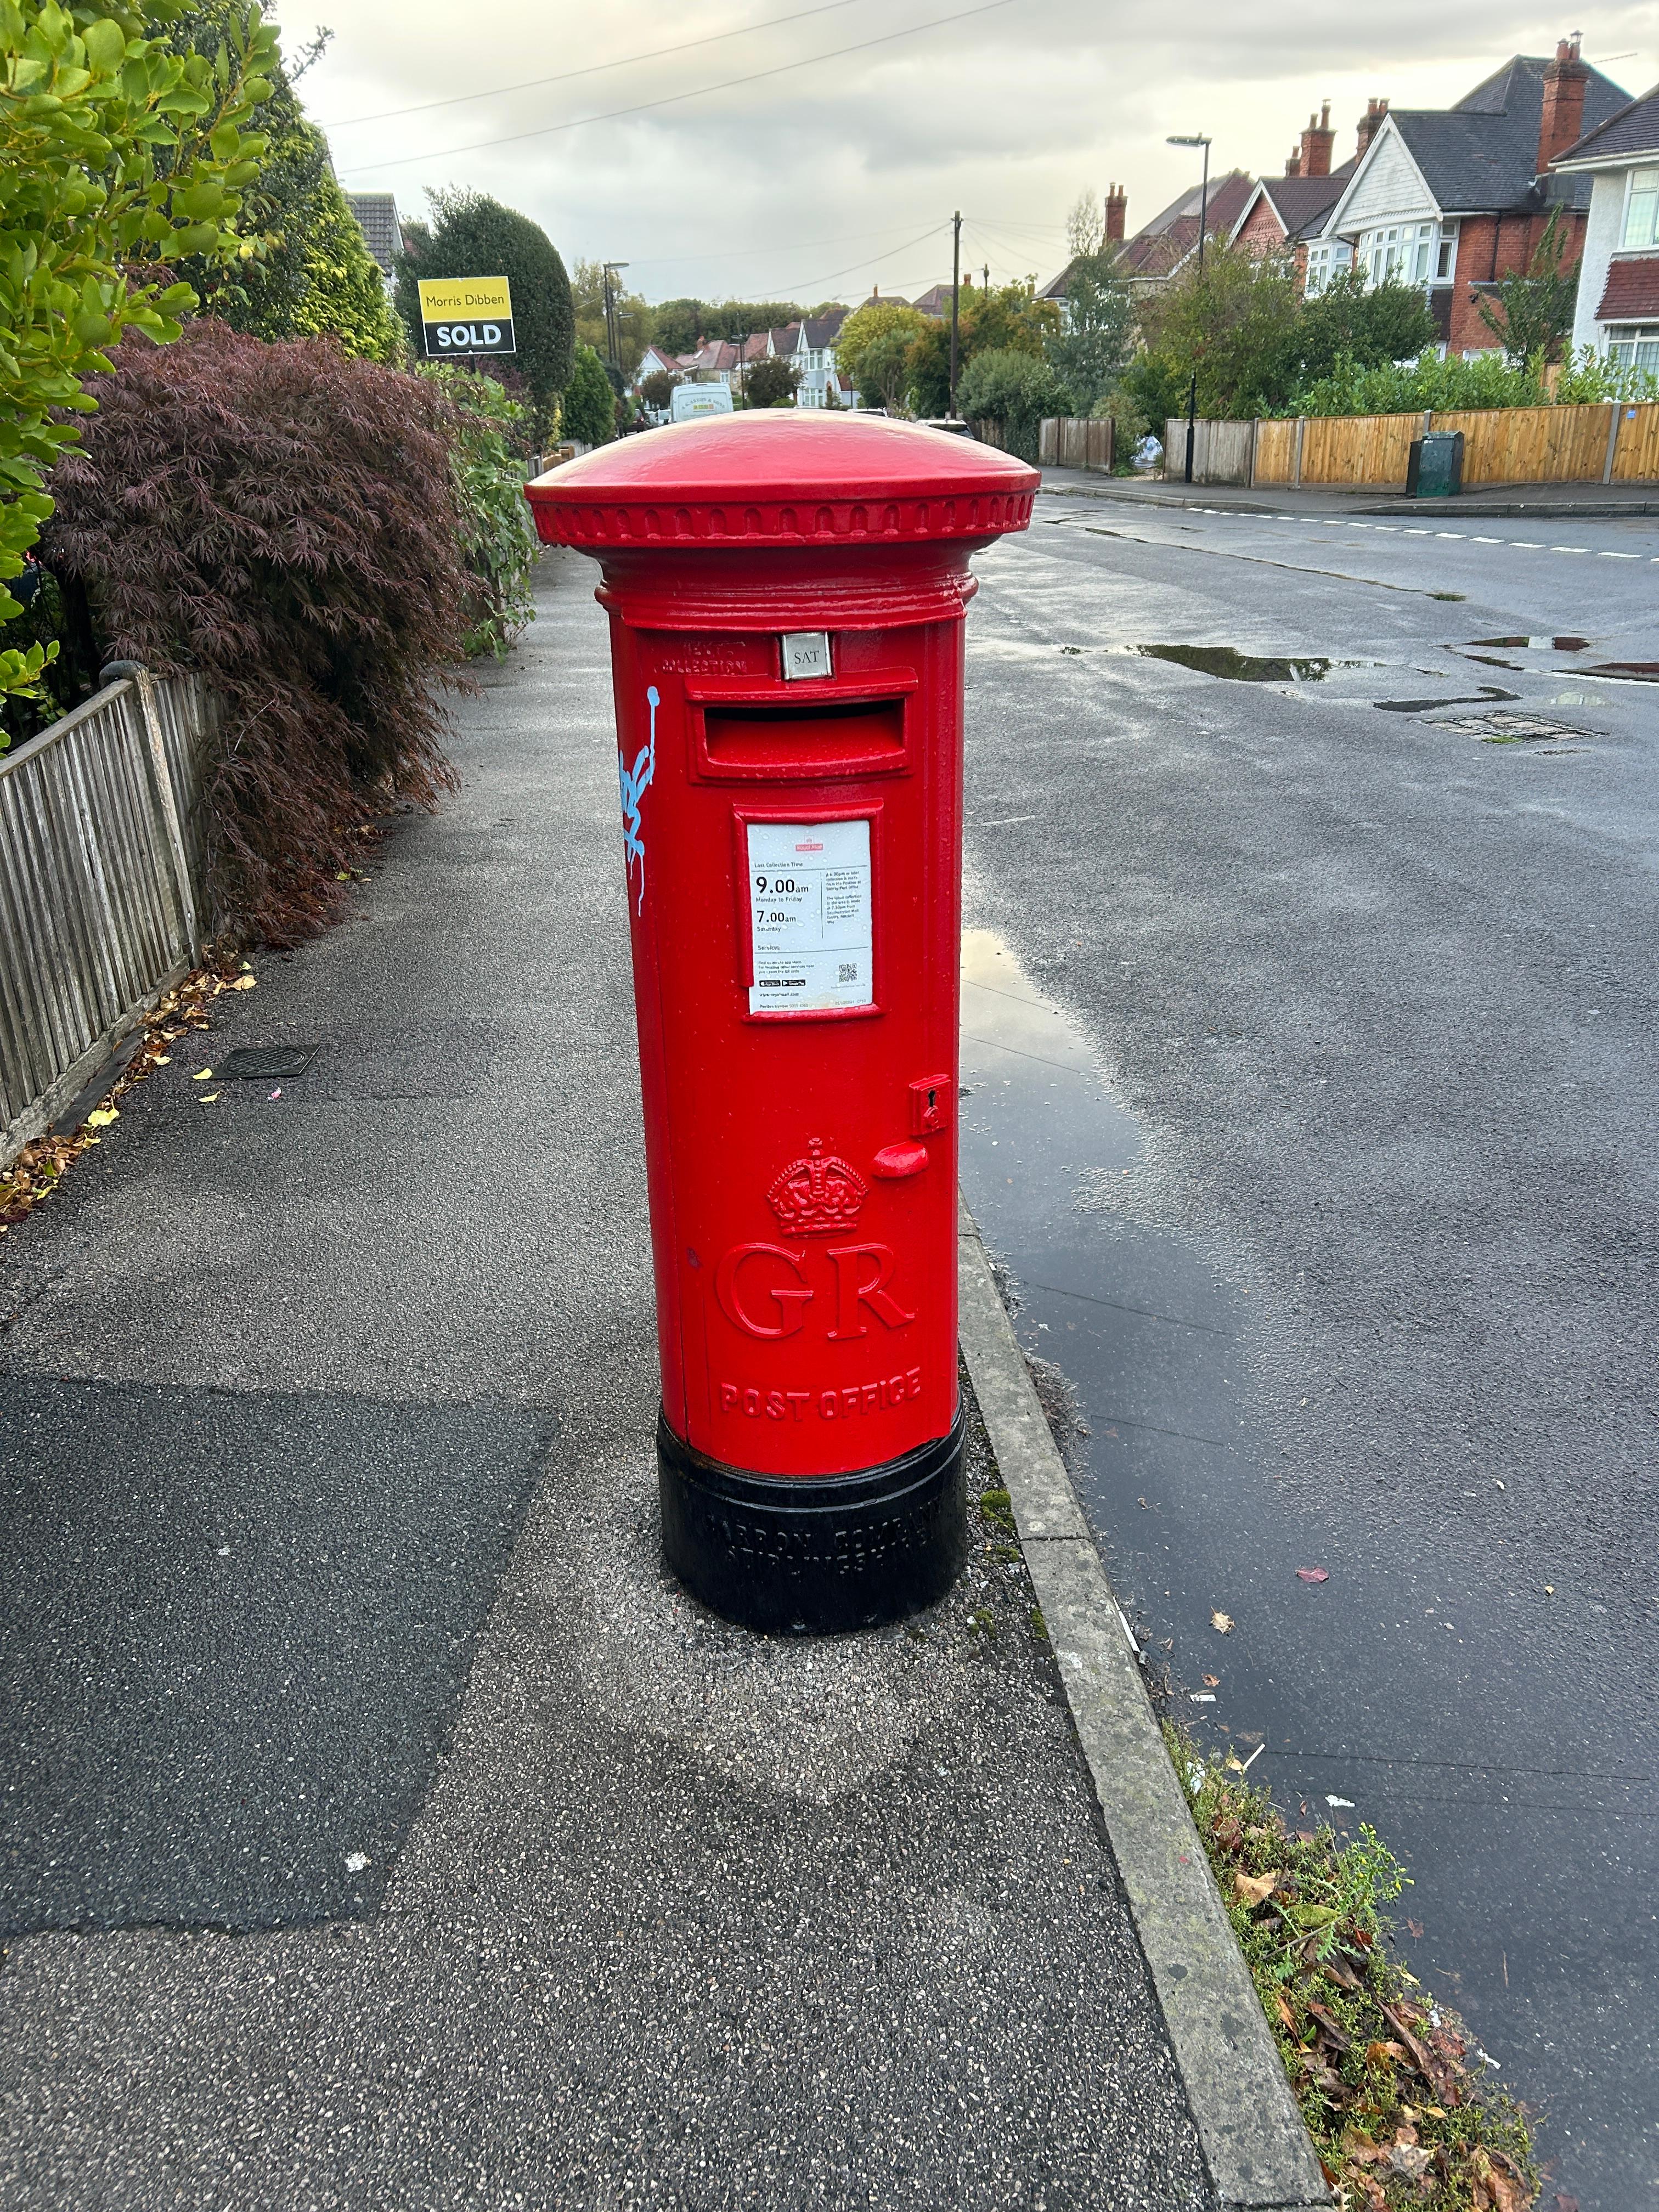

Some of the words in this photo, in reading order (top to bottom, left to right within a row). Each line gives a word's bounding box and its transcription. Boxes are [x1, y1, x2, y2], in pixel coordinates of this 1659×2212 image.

[426, 296, 461, 307] Morris
[465, 294, 504, 305] Dibben
[437, 324, 501, 347] SOLD
[794, 651, 820, 664] SAT
[756, 876, 809, 893] 9.00am
[757, 911, 796, 922] 7.00am
[715, 1243, 915, 1341] GR
[721, 1381, 810, 1421] POST
[818, 1366, 921, 1420] OFFICE
